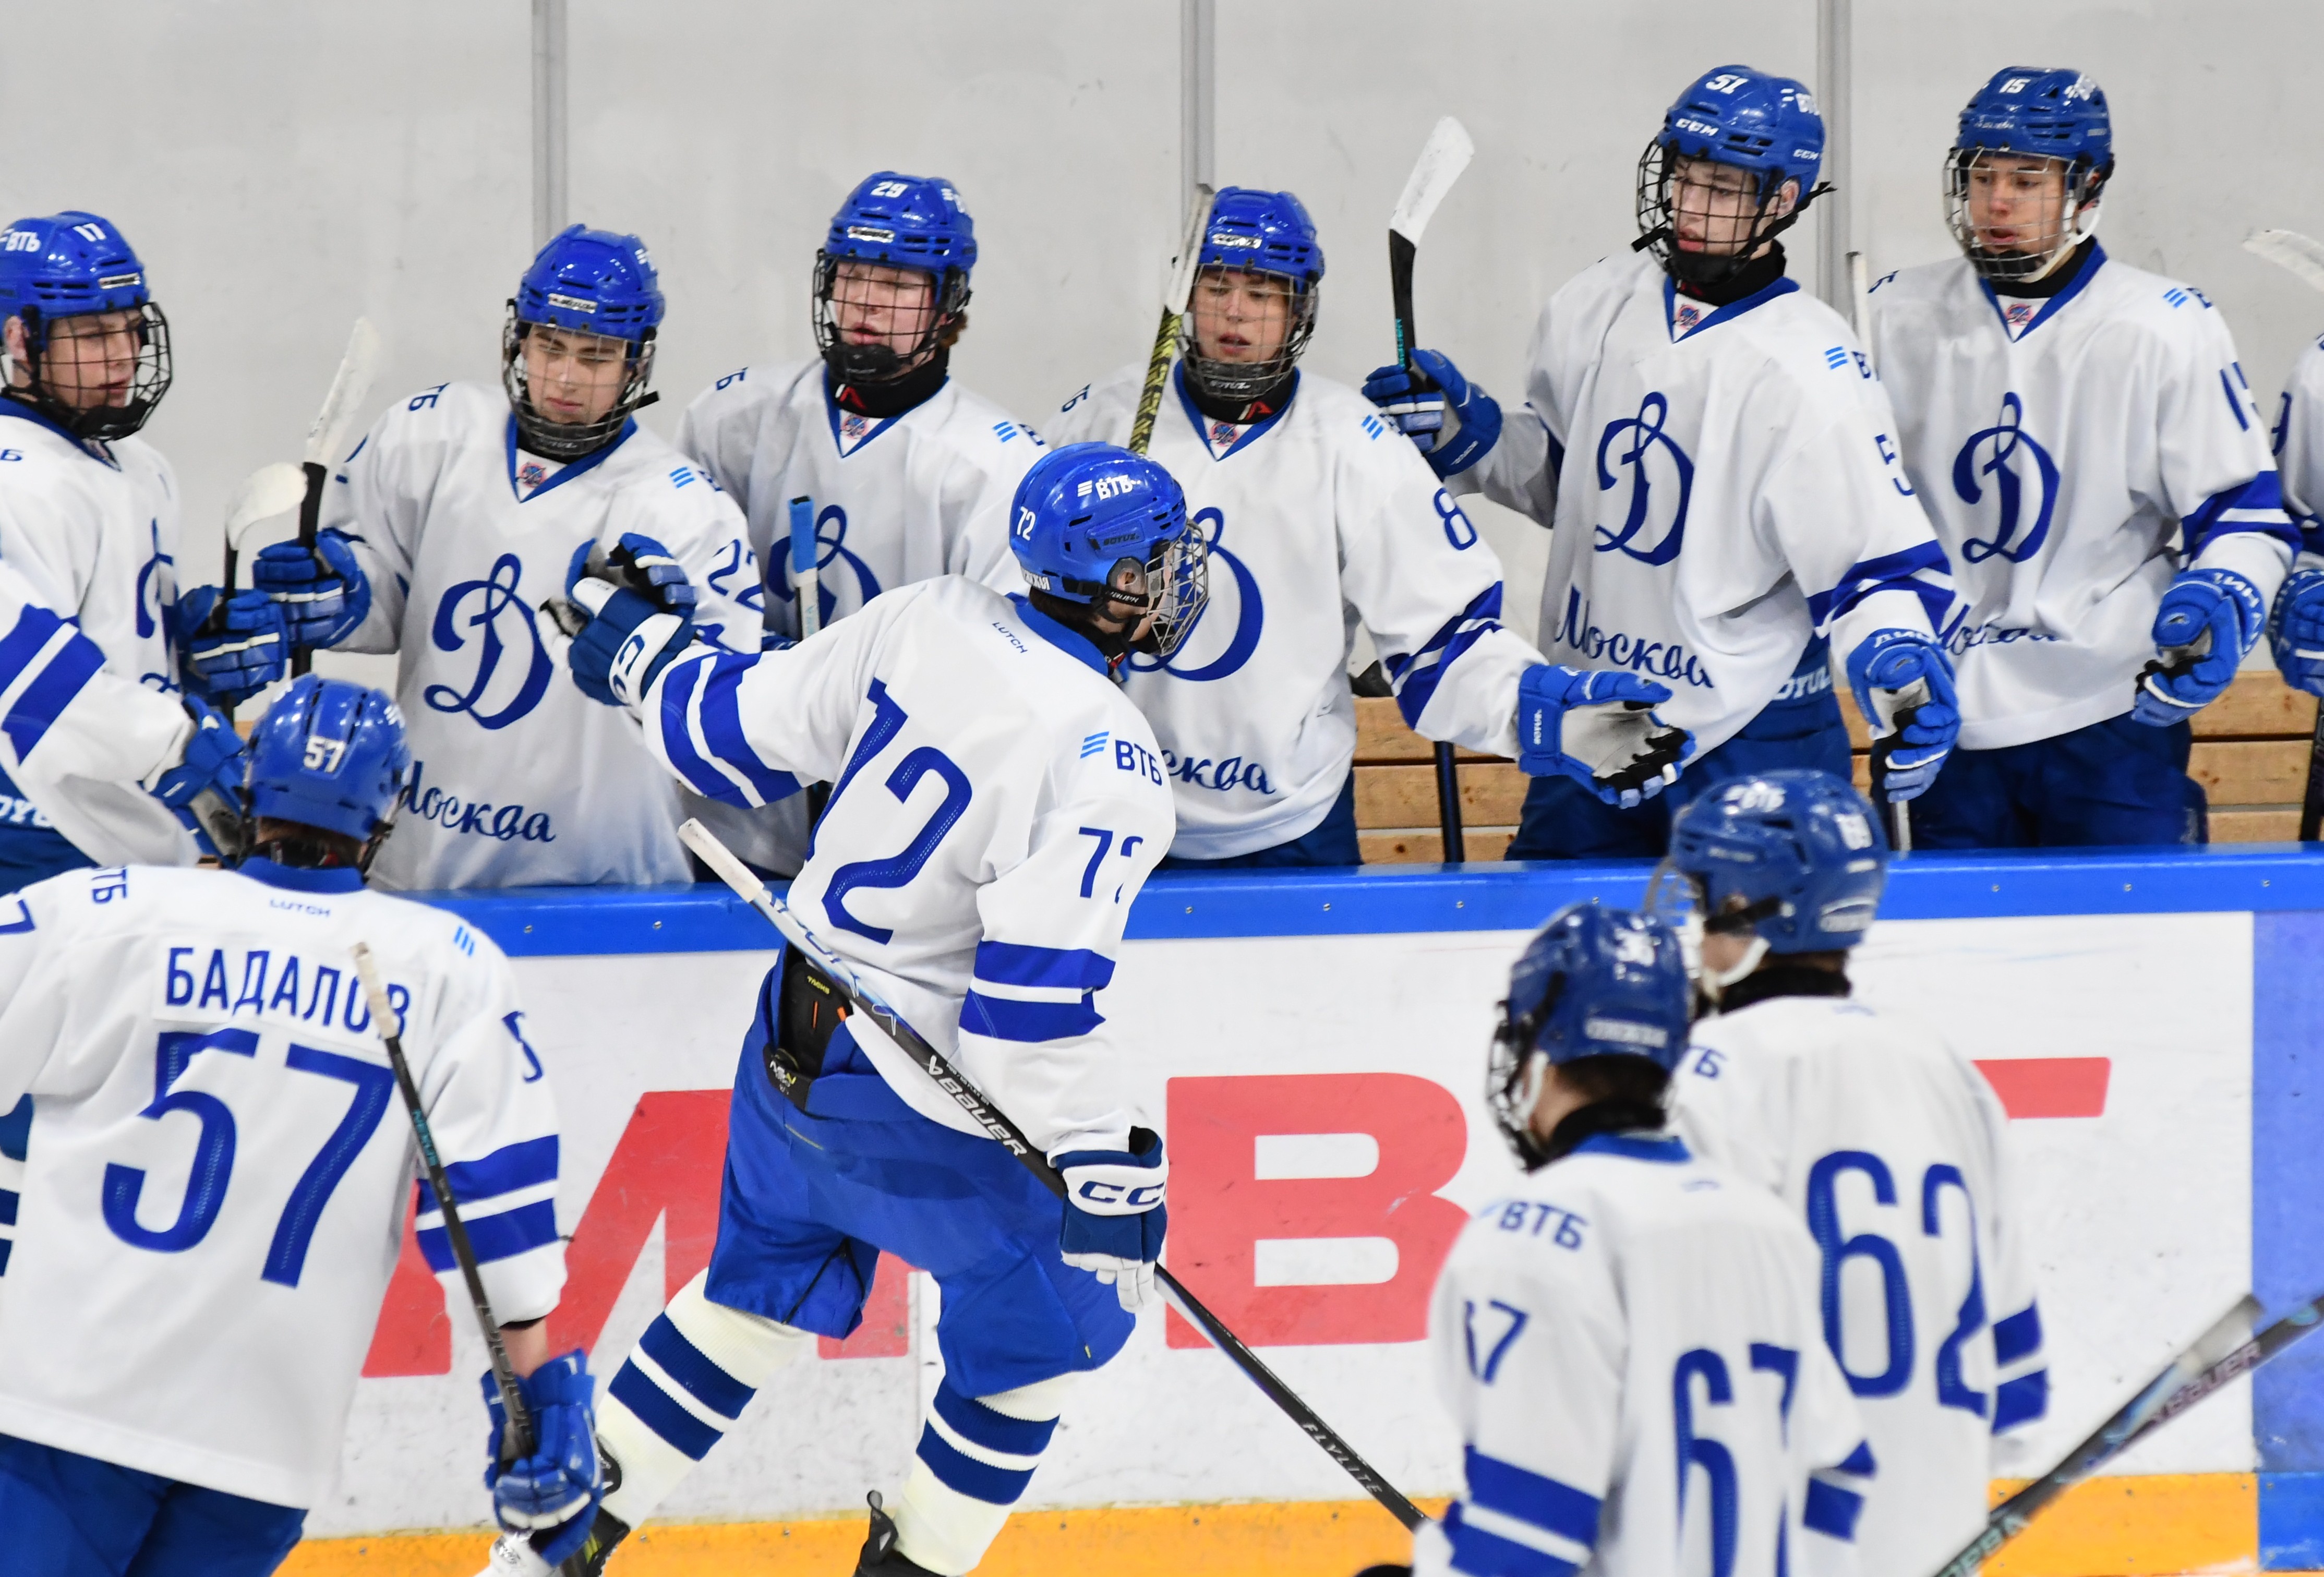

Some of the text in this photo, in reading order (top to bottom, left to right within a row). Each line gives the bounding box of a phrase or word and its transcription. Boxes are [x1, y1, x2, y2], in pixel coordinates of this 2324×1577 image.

[1705, 74, 1749, 94] 51
[1999, 78, 2031, 94] 15
[1675, 118, 1719, 137] CCM
[870, 180, 909, 198] 29
[1095, 474, 1134, 501] ВТБ
[1017, 506, 1036, 541] 72
[992, 622, 1028, 654] LUTCH
[303, 736, 346, 773] 57
[1115, 739, 1164, 787] ВТБ
[807, 677, 972, 946] 72
[90, 866, 127, 904] ТБ
[269, 898, 331, 918] LUTCH
[165, 946, 411, 1040] БАДАЛОВ
[938, 1077, 1028, 1156] BAUER
[101, 1027, 395, 1289] 57
[1078, 1181, 1166, 1206] CC
[1498, 1199, 1589, 1251] ВТБ
[1807, 1150, 1989, 1420] 62
[1302, 1423, 1383, 1494] FLYLITE
